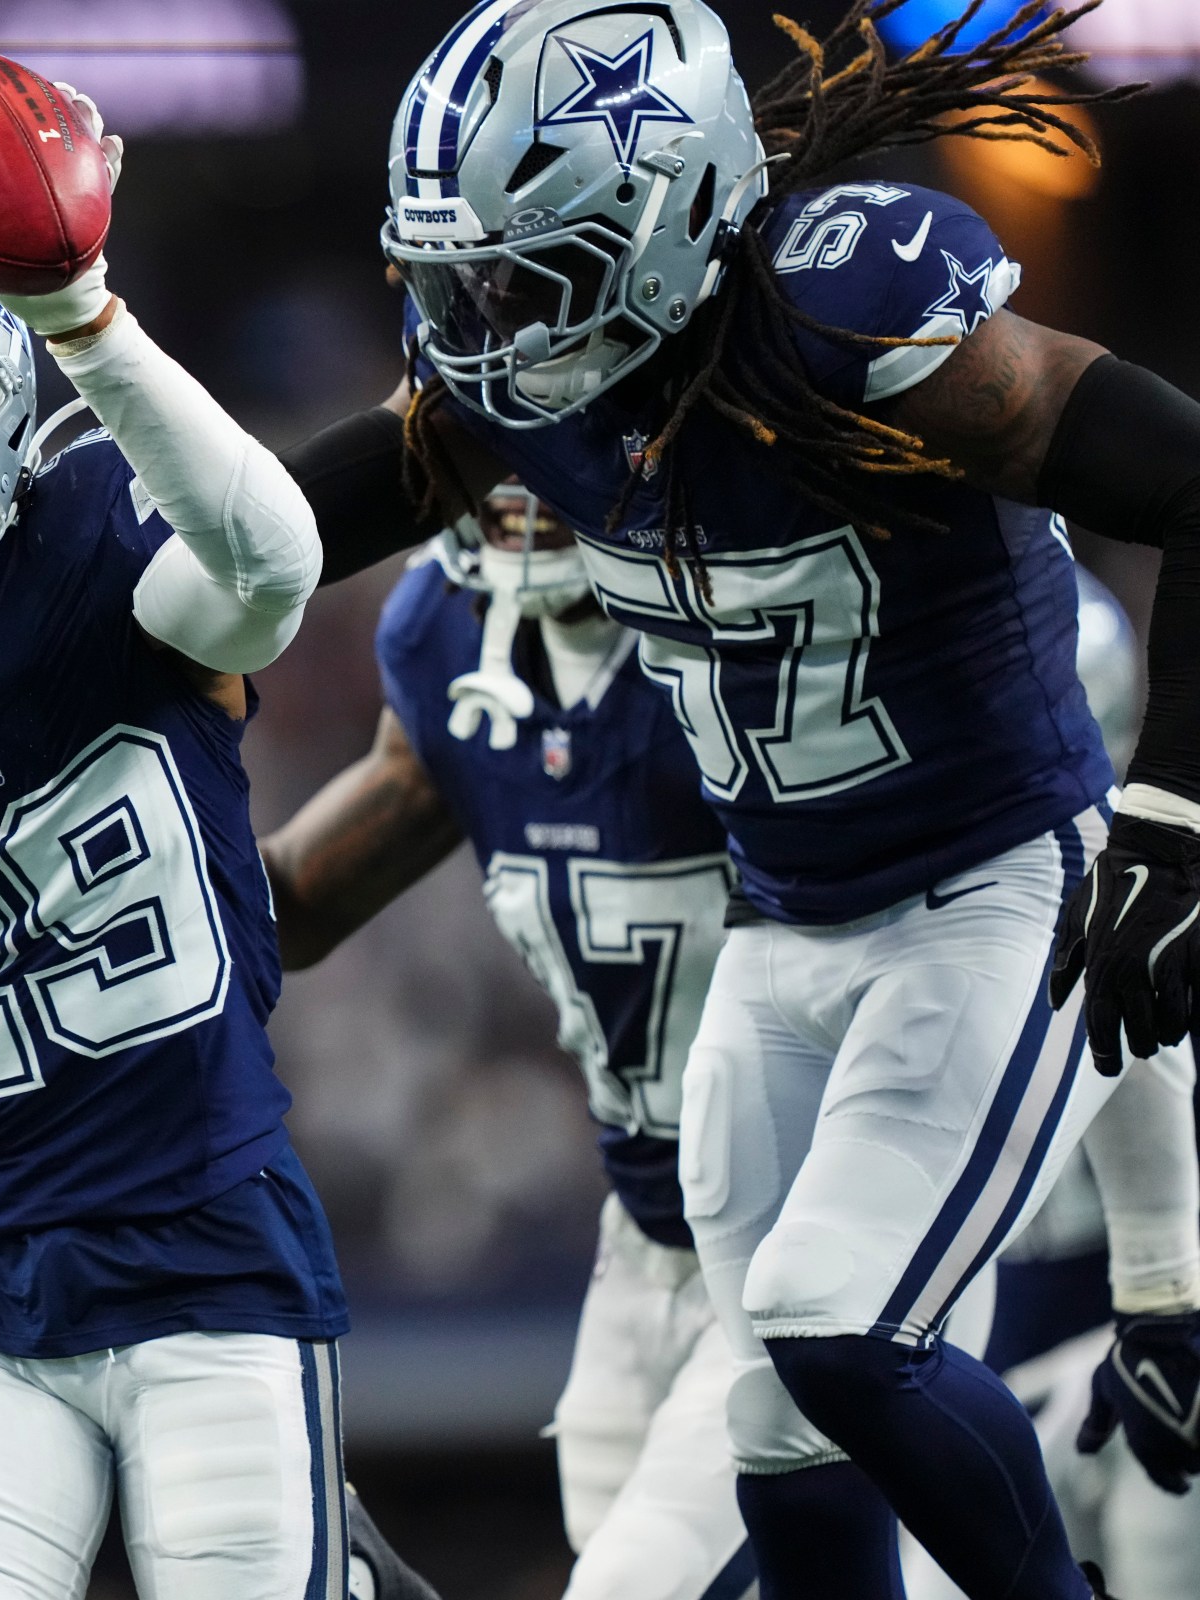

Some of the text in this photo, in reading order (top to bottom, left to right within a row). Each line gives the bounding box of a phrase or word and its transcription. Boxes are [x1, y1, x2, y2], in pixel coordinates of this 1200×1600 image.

[38, 128, 62, 143] 1
[53, 107, 74, 152] LEAGUE
[404, 208, 457, 224] COWBOYS
[506, 215, 557, 238] OAKLEY
[771, 184, 912, 275] 57
[573, 524, 913, 804] 57
